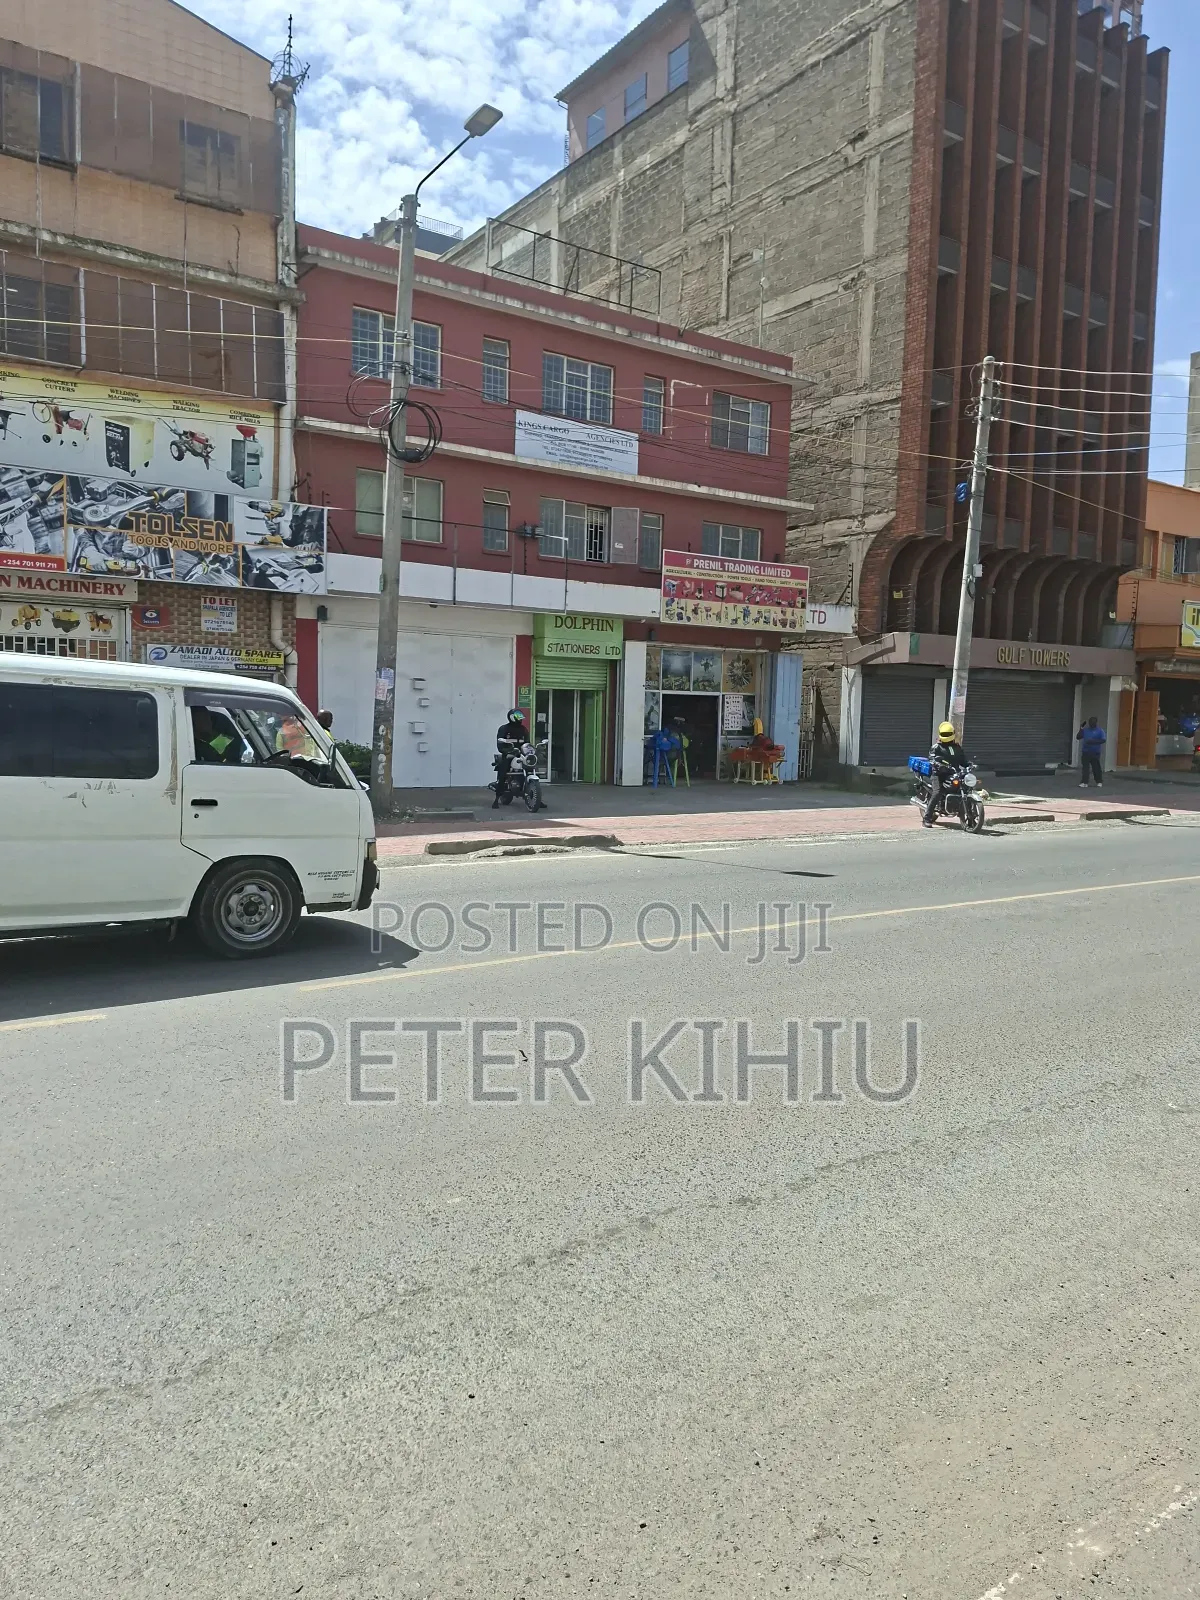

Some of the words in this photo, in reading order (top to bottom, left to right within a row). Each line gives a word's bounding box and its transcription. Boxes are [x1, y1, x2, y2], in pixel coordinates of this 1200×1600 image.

[42, 378, 78, 387] CONCRETE
[45, 384, 76, 392] CUTTERS
[110, 388, 139, 398] WELDING
[172, 404, 200, 413] TRACTOR
[543, 424, 570, 434] CARGO
[586, 432, 620, 446] AGENCIES
[621, 439, 633, 448] LTD
[12, 501, 32, 517] TOLSEN
[128, 512, 233, 542] TOLSEN
[129, 534, 168, 547] TOOLS
[173, 540, 196, 550] AND
[200, 542, 233, 554] MORE
[694, 559, 722, 571] PRENIL
[724, 562, 759, 574] TRADING
[761, 566, 791, 578] LIMITED
[17, 576, 126, 596] MACHINERY
[219, 598, 236, 606] LET
[554, 616, 614, 632] DOLPHIN
[806, 610, 826, 625] TD
[170, 646, 212, 655] ZAMADI
[215, 647, 241, 656] AUTO
[244, 650, 282, 659] SPARES
[547, 642, 600, 654] STATIONERS
[605, 646, 620, 655] LTD
[997, 646, 1025, 664] GULF
[1029, 648, 1071, 668] TOWERS
